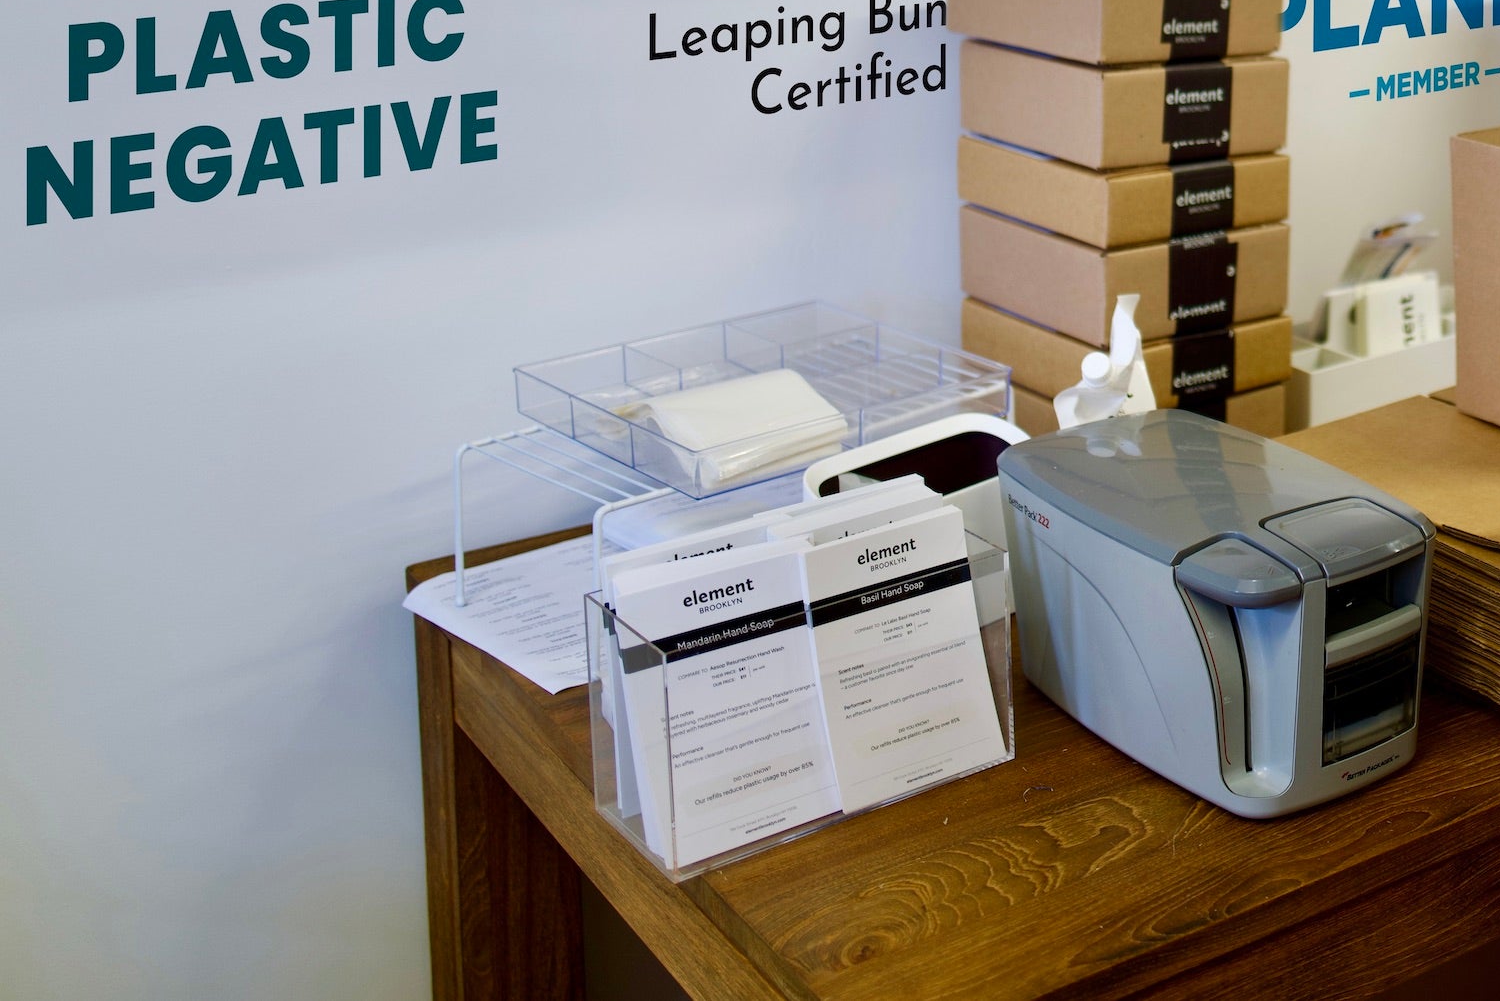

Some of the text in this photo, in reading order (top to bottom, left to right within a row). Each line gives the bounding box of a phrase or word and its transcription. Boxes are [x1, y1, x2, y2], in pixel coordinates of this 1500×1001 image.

[649, 5, 846, 62] Leaping
[1163, 18, 1219, 35] element
[750, 43, 947, 115] Certified
[1376, 60, 1481, 102] MEMBER
[1165, 88, 1224, 105] element
[26, 89, 499, 227] NEGATIVE
[1176, 185, 1232, 207] element
[1173, 365, 1228, 389] element
[1038, 513, 1050, 529] 222
[857, 538, 917, 565] element
[870, 556, 907, 572] BROOKLYN
[683, 578, 755, 608] element
[861, 581, 924, 605] Basil Hand Soap
[699, 597, 743, 614] BROOKLYN
[677, 618, 775, 650] Mandarin Hand Soap
[710, 663, 726, 671] Aesop
[726, 654, 757, 666] Resurrection
[757, 650, 771, 658] Hand
[852, 663, 864, 671] notes
[751, 696, 772, 706] uplifting
[773, 689, 795, 699] Mandarin
[795, 684, 811, 693] orange
[844, 698, 872, 710] Performance
[680, 710, 694, 718] notes
[697, 717, 726, 729] herbaceous
[726, 711, 749, 721] rosemary
[852, 708, 871, 717] effective
[682, 756, 703, 767] effective
[704, 749, 724, 759] cleanser
[724, 744, 738, 753] that's
[739, 739, 754, 749] gentle
[754, 733, 772, 743] enough
[780, 724, 801, 735] frequent
[892, 736, 907, 744] reduce
[907, 730, 921, 739] plastic
[922, 726, 934, 734] usage
[672, 746, 703, 759] Performance
[754, 765, 772, 776] KNOW?
[694, 761, 814, 806] Our refills reduce plastic usage by over 85%
